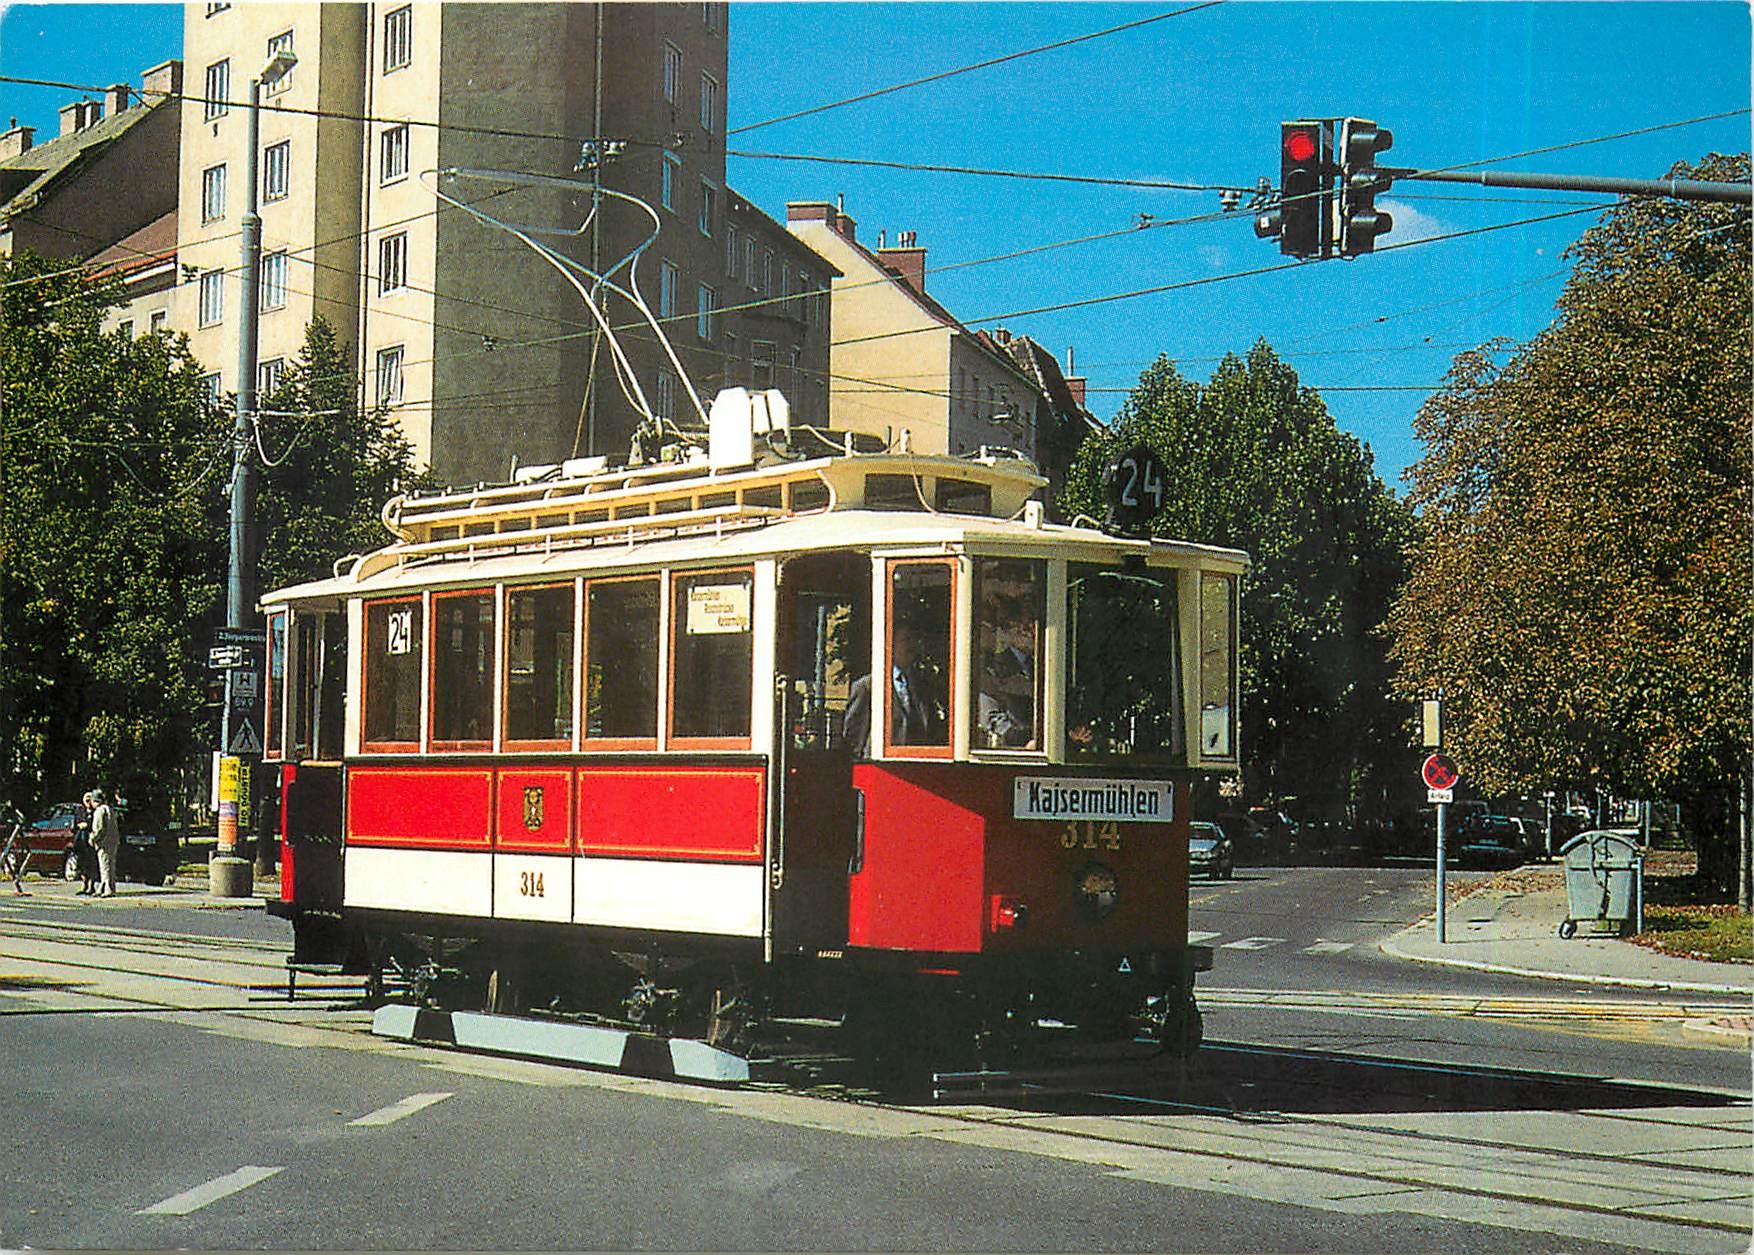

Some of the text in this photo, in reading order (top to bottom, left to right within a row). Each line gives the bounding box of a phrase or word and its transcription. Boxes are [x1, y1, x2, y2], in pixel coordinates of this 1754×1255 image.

[1122, 458, 1162, 507] 24
[391, 616, 408, 654] 24
[1060, 821, 1120, 850] 314
[520, 871, 545, 898] 314
